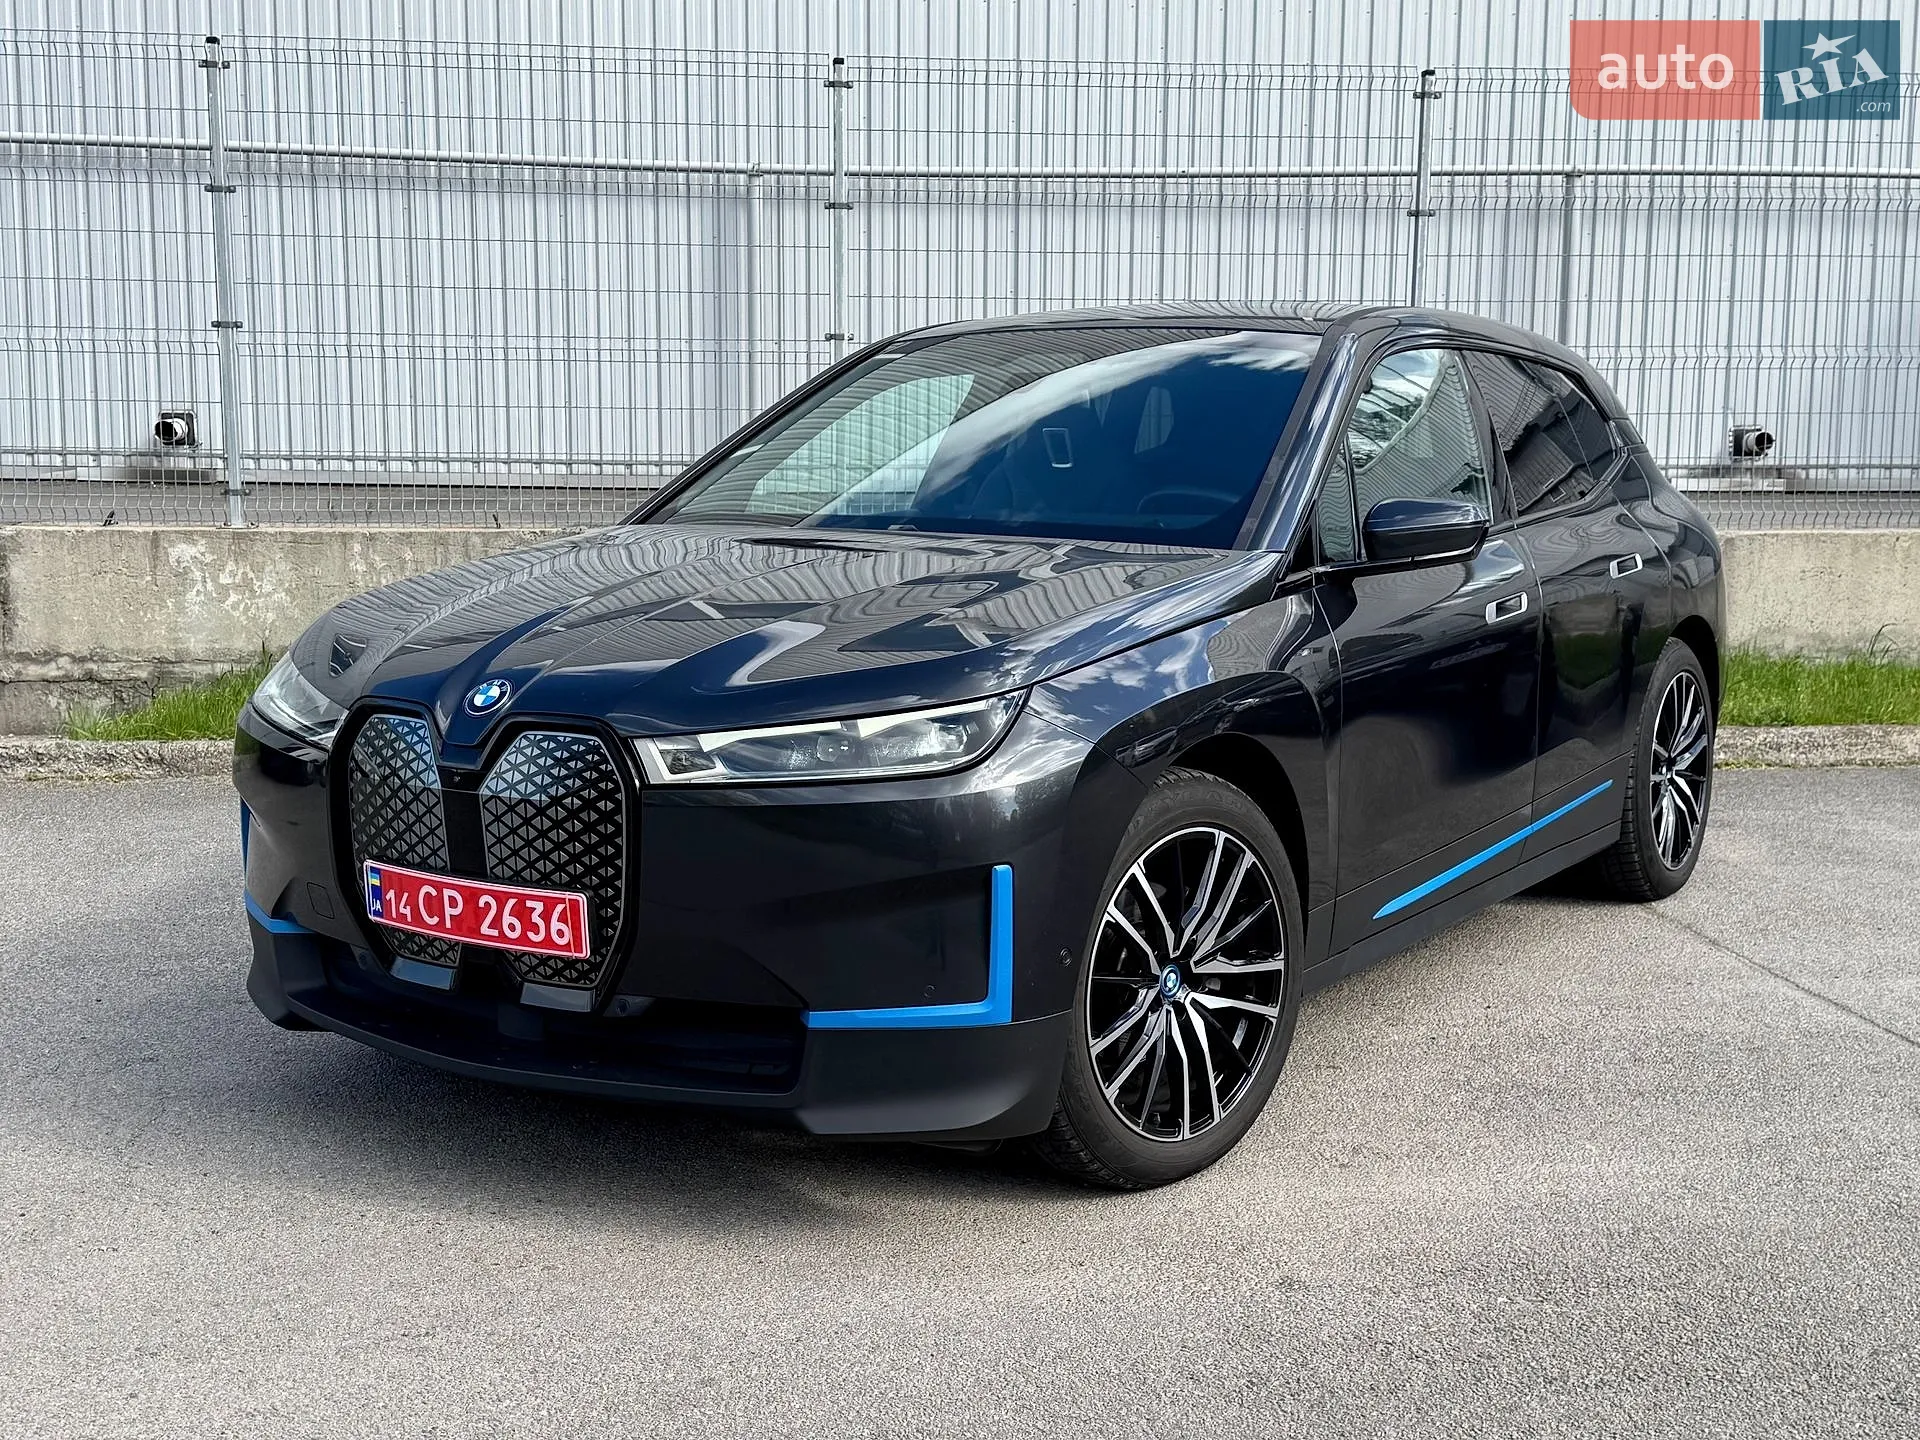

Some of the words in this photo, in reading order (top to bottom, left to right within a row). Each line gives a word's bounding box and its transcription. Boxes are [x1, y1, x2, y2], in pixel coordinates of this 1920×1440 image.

[385, 889, 412, 922] 14
[418, 885, 464, 929] CP
[478, 894, 571, 946] 2636
